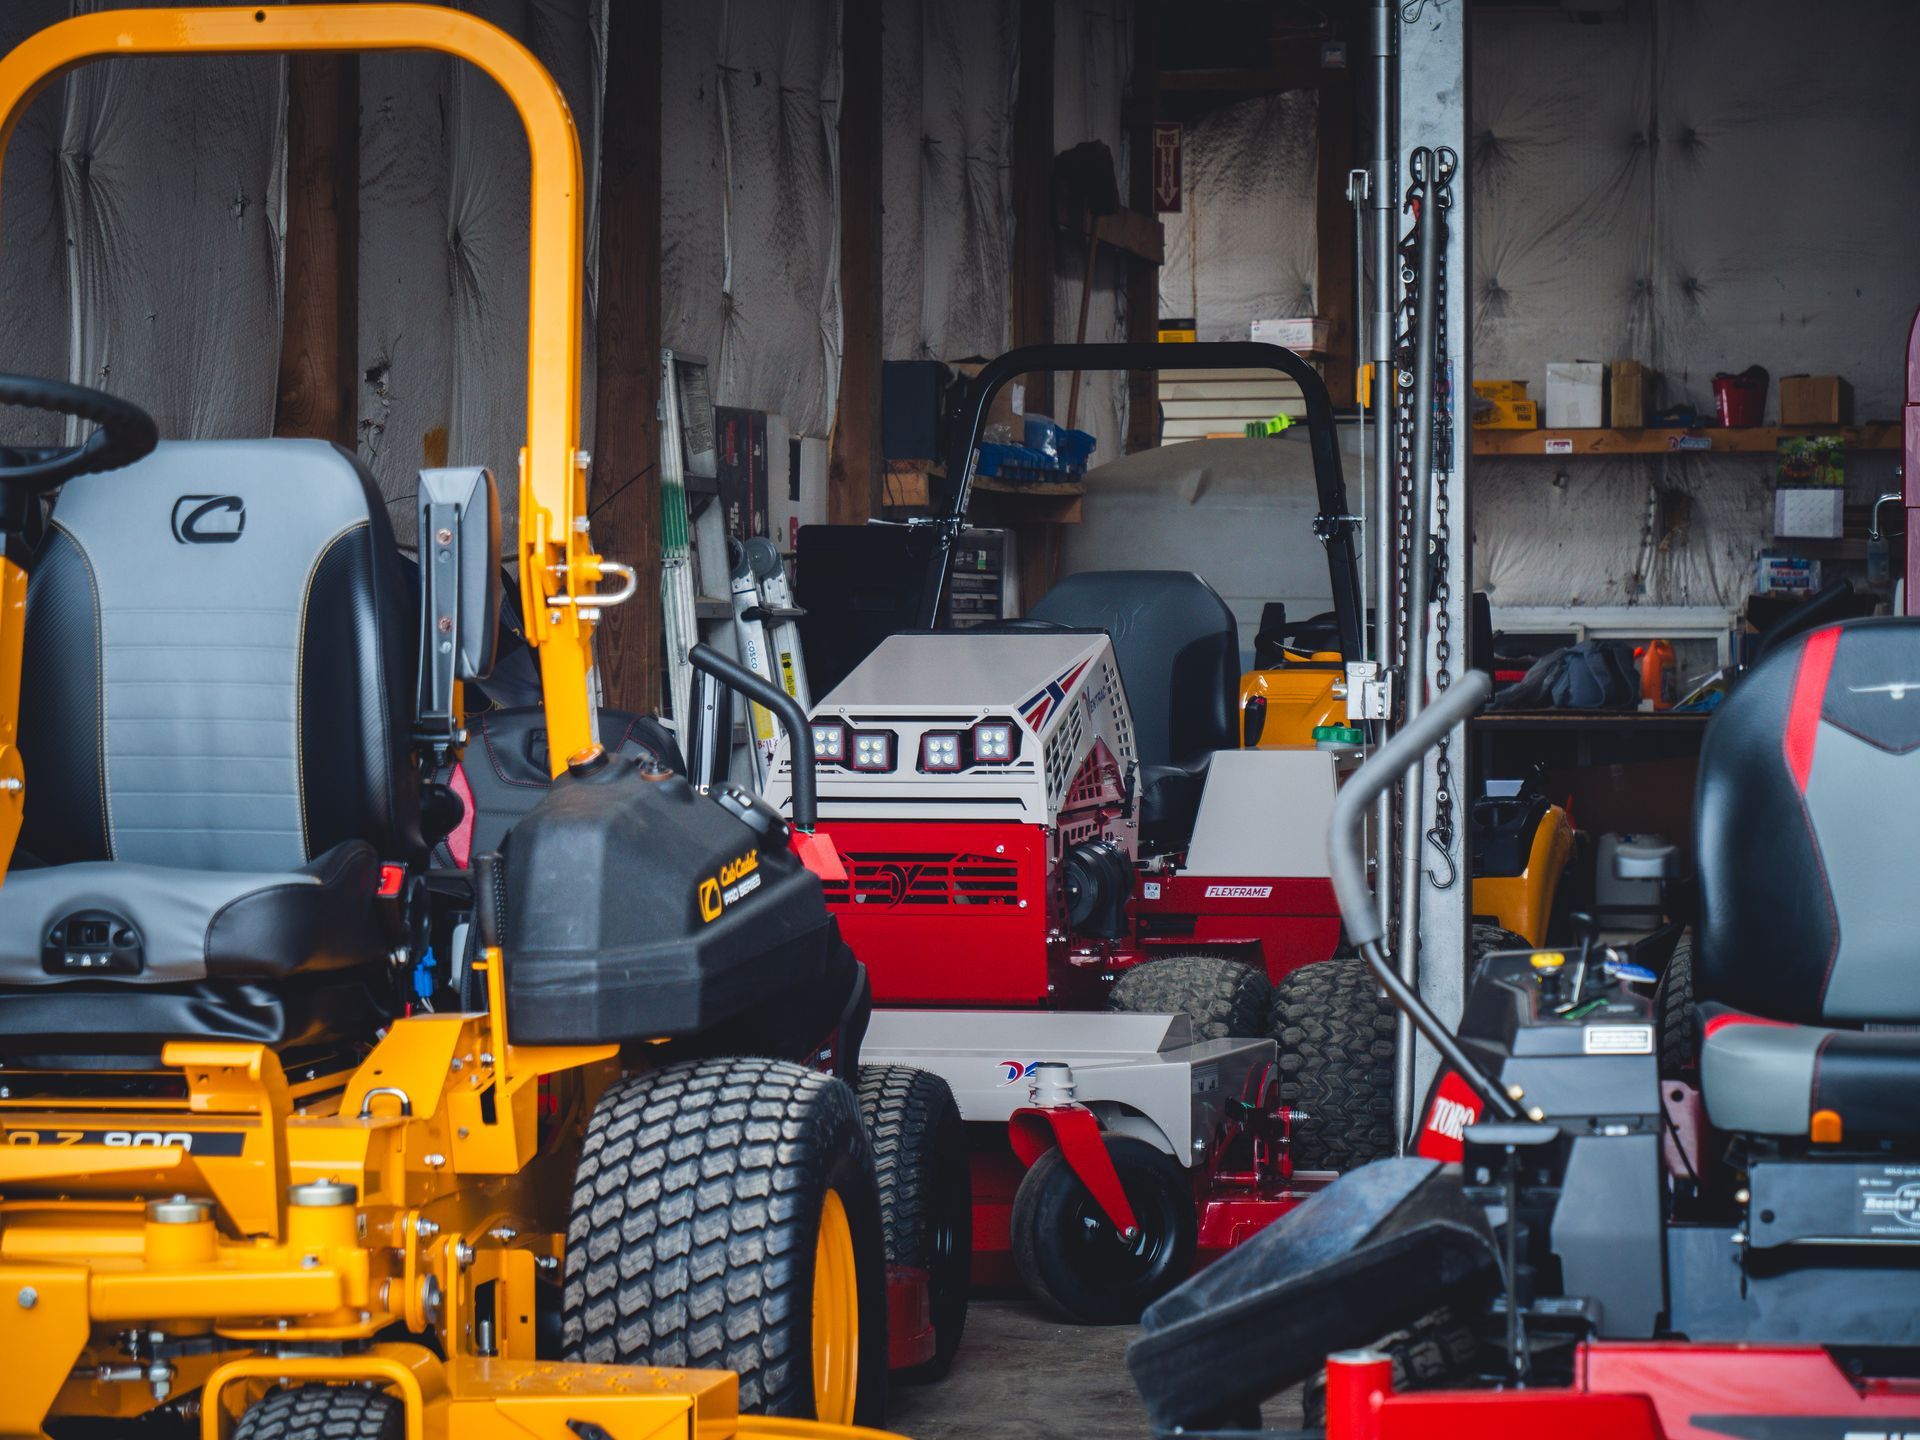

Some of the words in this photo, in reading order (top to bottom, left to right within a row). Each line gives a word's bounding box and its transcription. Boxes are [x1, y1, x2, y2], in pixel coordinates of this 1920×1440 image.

[1159, 134, 1176, 146] FIRE
[747, 640, 759, 670] COSCO
[722, 887, 739, 906] PRO
[738, 873, 761, 898] SERIES
[1208, 887, 1269, 897] FLEXFRAME
[1865, 1197, 1915, 1210] Rental
